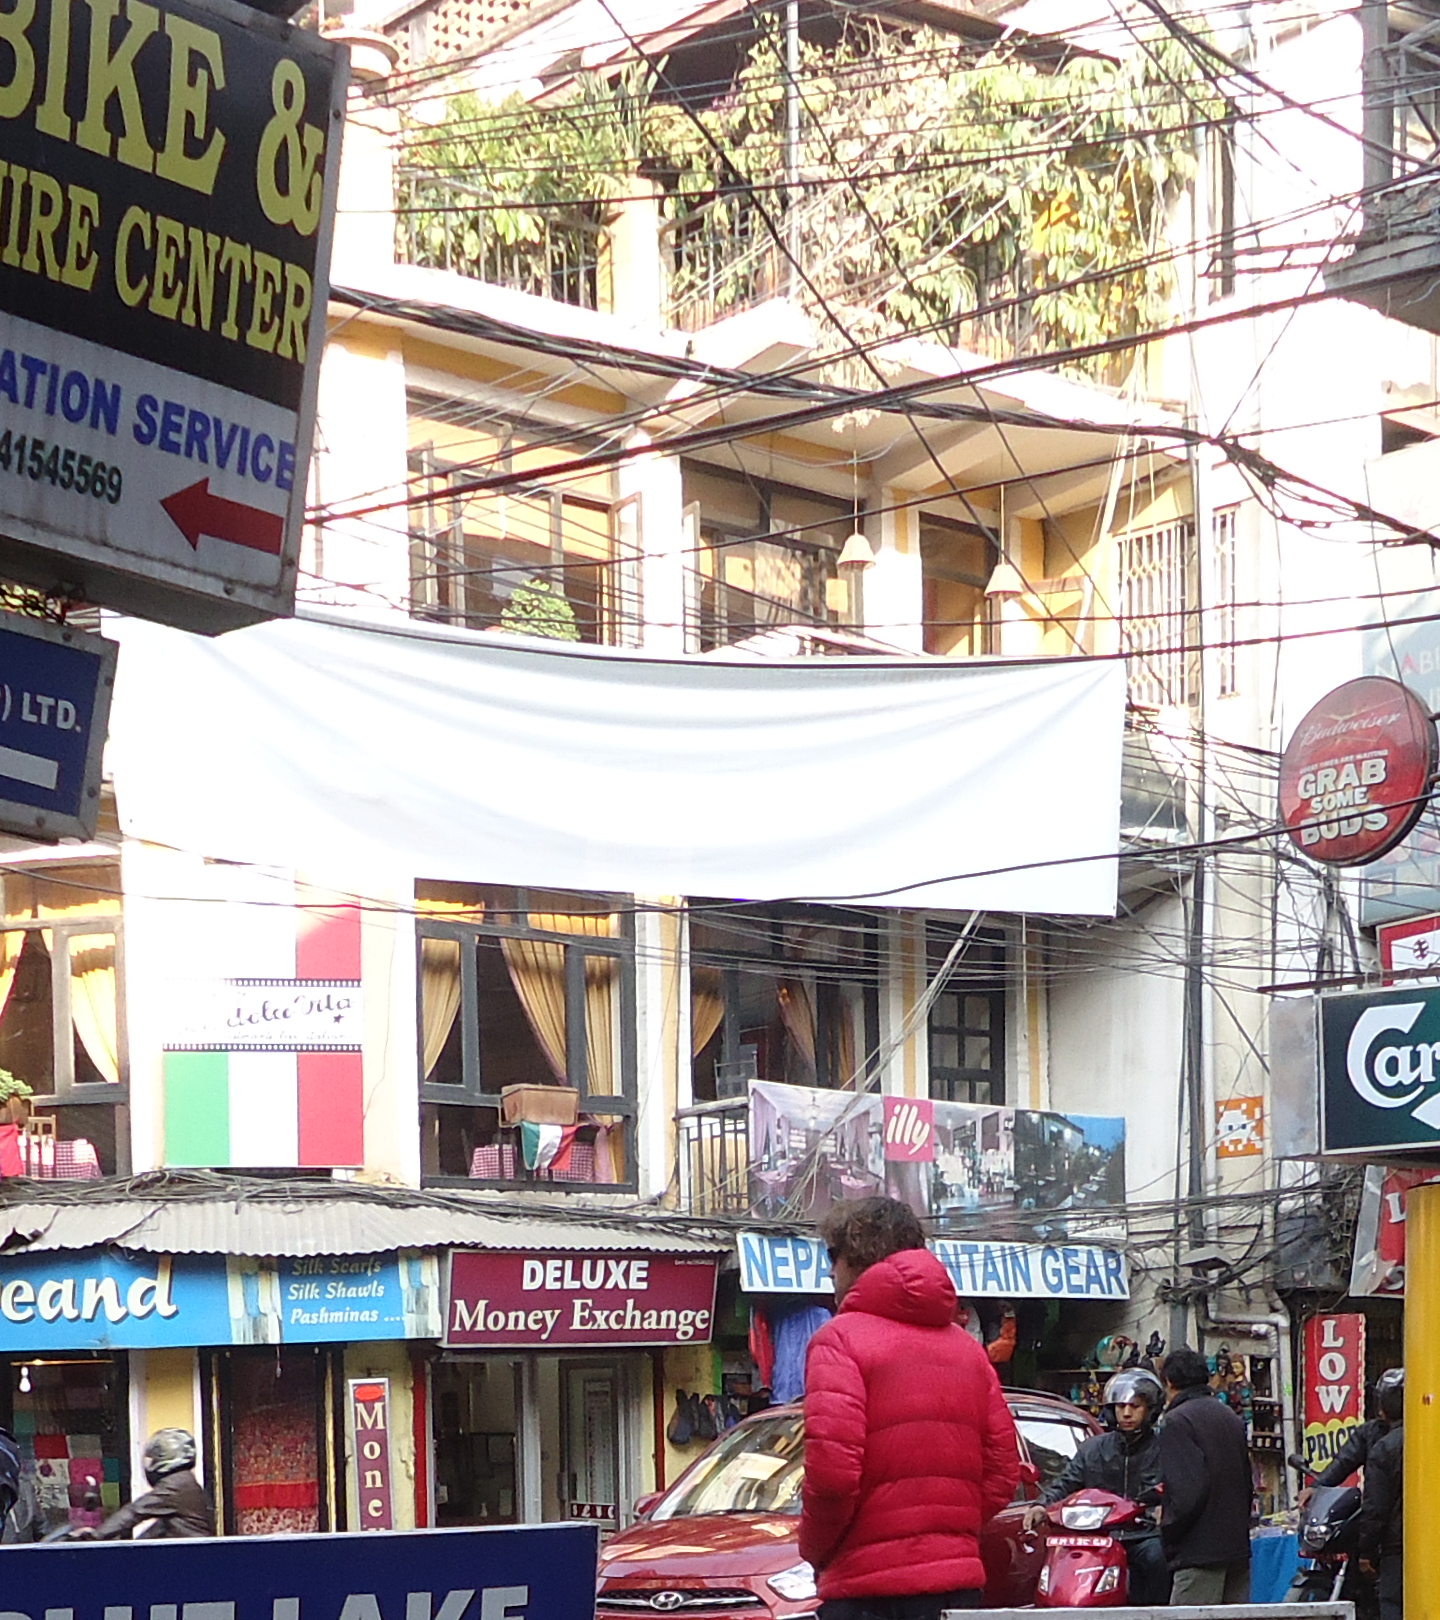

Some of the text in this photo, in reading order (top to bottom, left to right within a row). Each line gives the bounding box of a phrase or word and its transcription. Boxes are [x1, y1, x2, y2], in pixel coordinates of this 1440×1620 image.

[258, 59, 326, 237] &
[115, 205, 314, 364] CENTER
[133, 394, 297, 491] SERVICE
[19, 693, 82, 733] LTD.
[1300, 712, 1401, 746] Budweiser
[1298, 758, 1387, 800] GRAB
[1311, 787, 1368, 814] SOME
[1300, 804, 1388, 846] BUDS
[886, 1103, 930, 1155] illy
[291, 1256, 381, 1277] Silk Scarfs
[522, 1259, 649, 1292] DELUXE
[930, 1242, 1033, 1293] NTAIN
[1040, 1245, 1127, 1296] GEAR
[288, 1280, 385, 1300] Silk Shawls
[291, 1306, 379, 1325] Pashminas
[452, 1299, 710, 1340] Money Exchange
[1315, 1319, 1351, 1415] LOW
[355, 1402, 386, 1531] Mone
